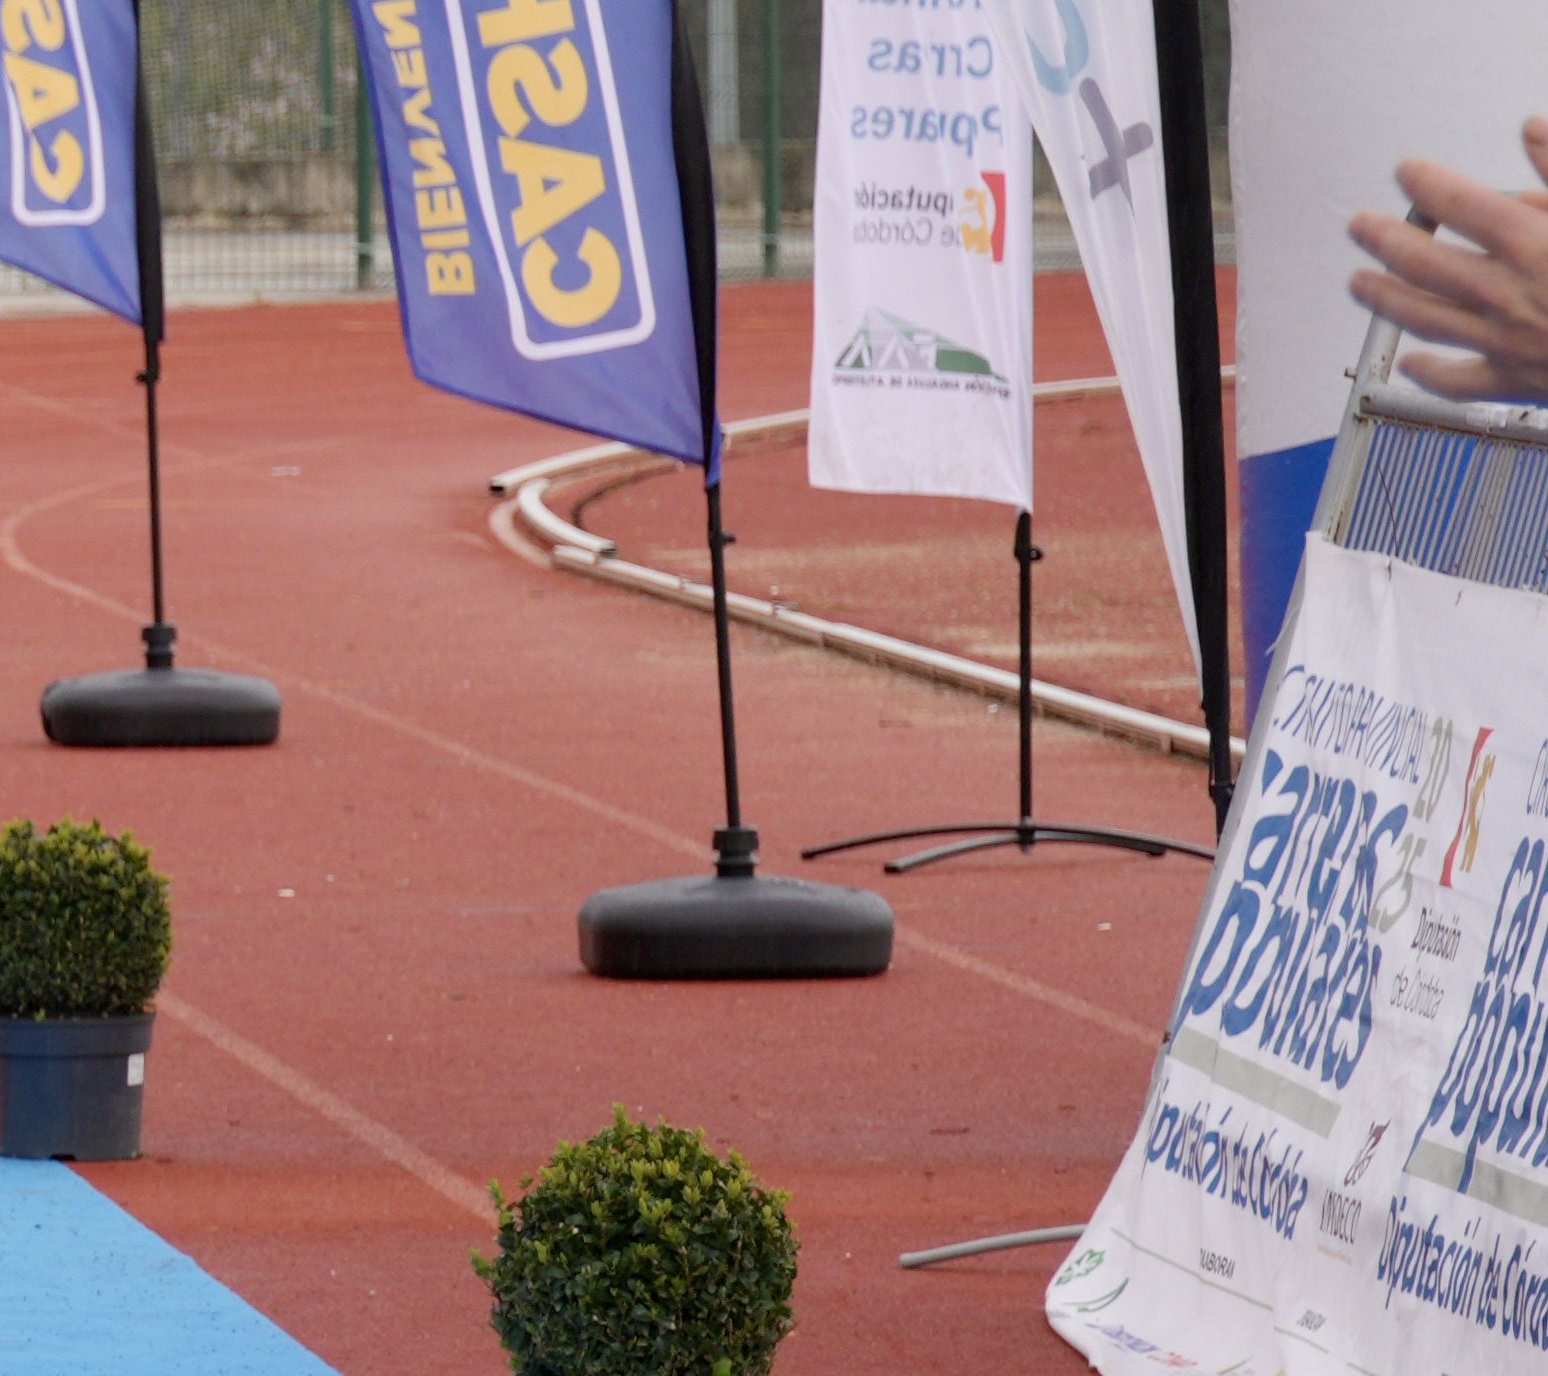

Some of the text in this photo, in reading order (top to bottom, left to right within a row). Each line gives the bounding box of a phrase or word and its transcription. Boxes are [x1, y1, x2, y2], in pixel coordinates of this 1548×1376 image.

[1412, 717, 1453, 823] 20
[1368, 832, 1427, 933] 25
[1377, 1196, 1483, 1310] Diputación
[1475, 1234, 1502, 1330] de
